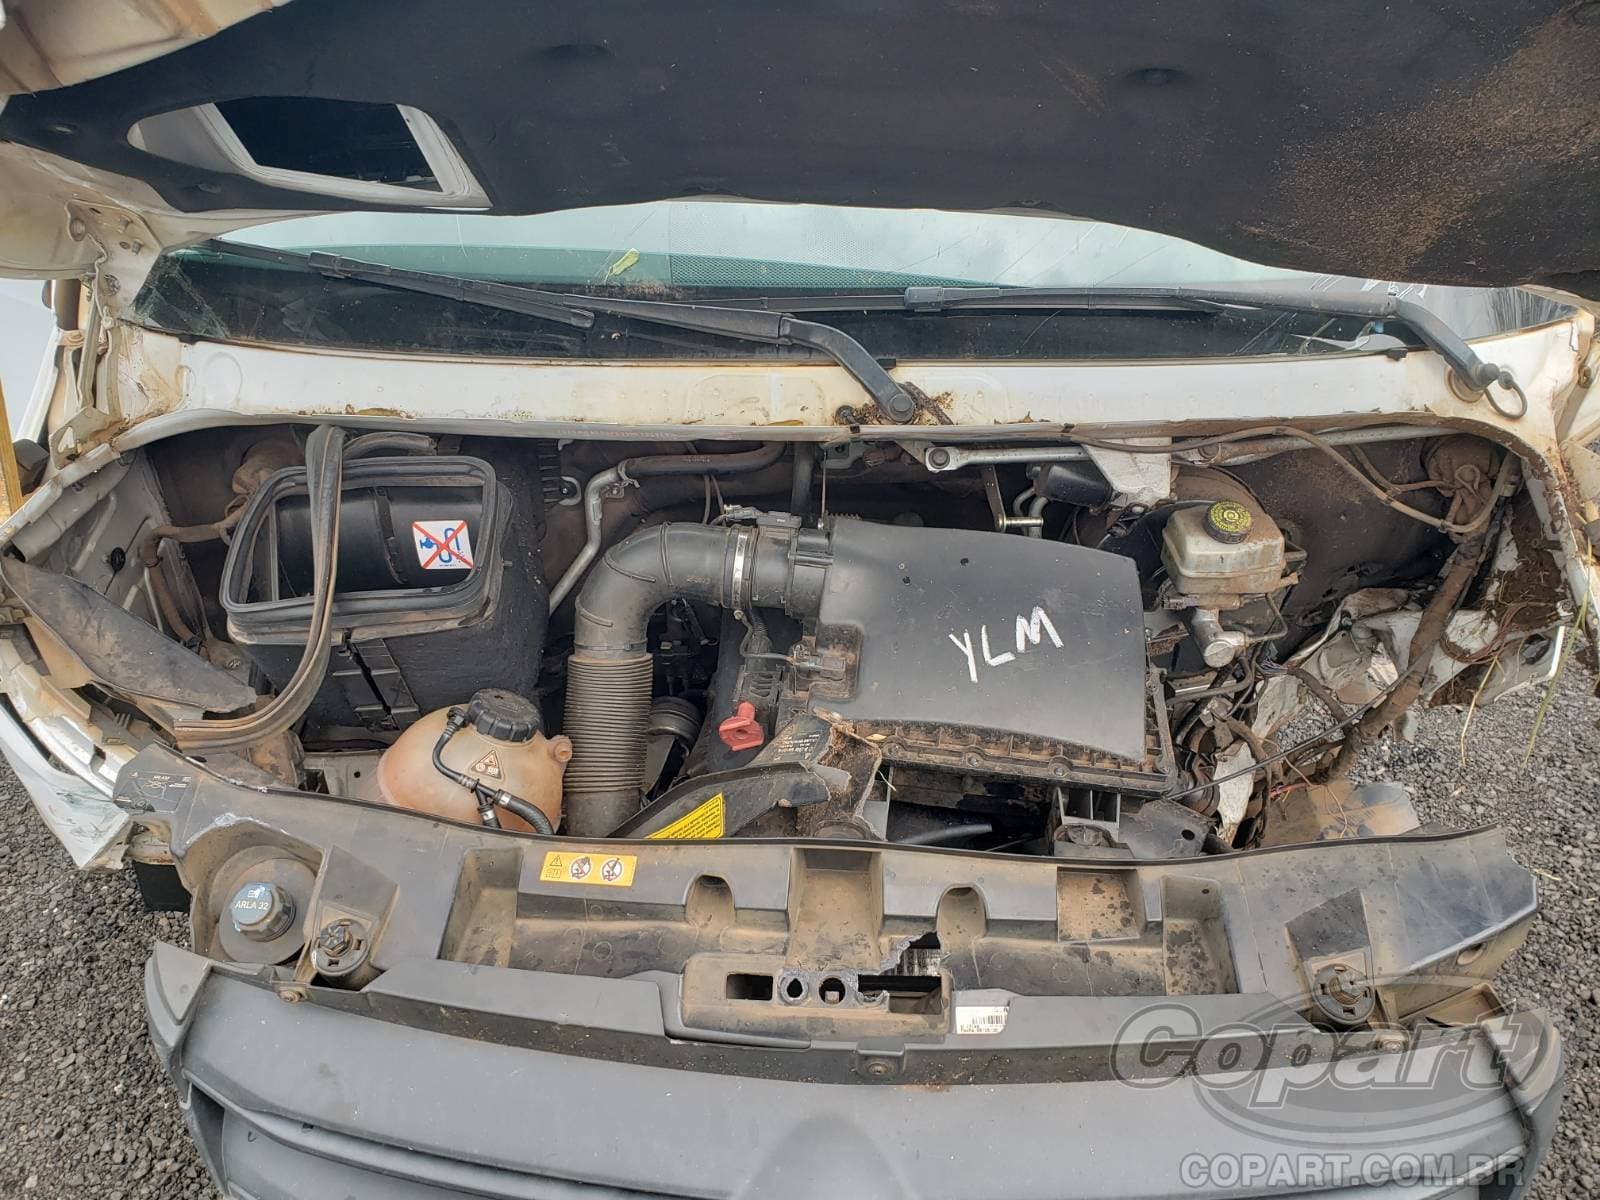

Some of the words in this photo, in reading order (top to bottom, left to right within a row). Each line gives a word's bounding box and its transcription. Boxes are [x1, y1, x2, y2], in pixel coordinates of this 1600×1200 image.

[948, 606, 1064, 683] YLM
[234, 900, 257, 910] ARLA
[258, 901, 269, 910] 32
